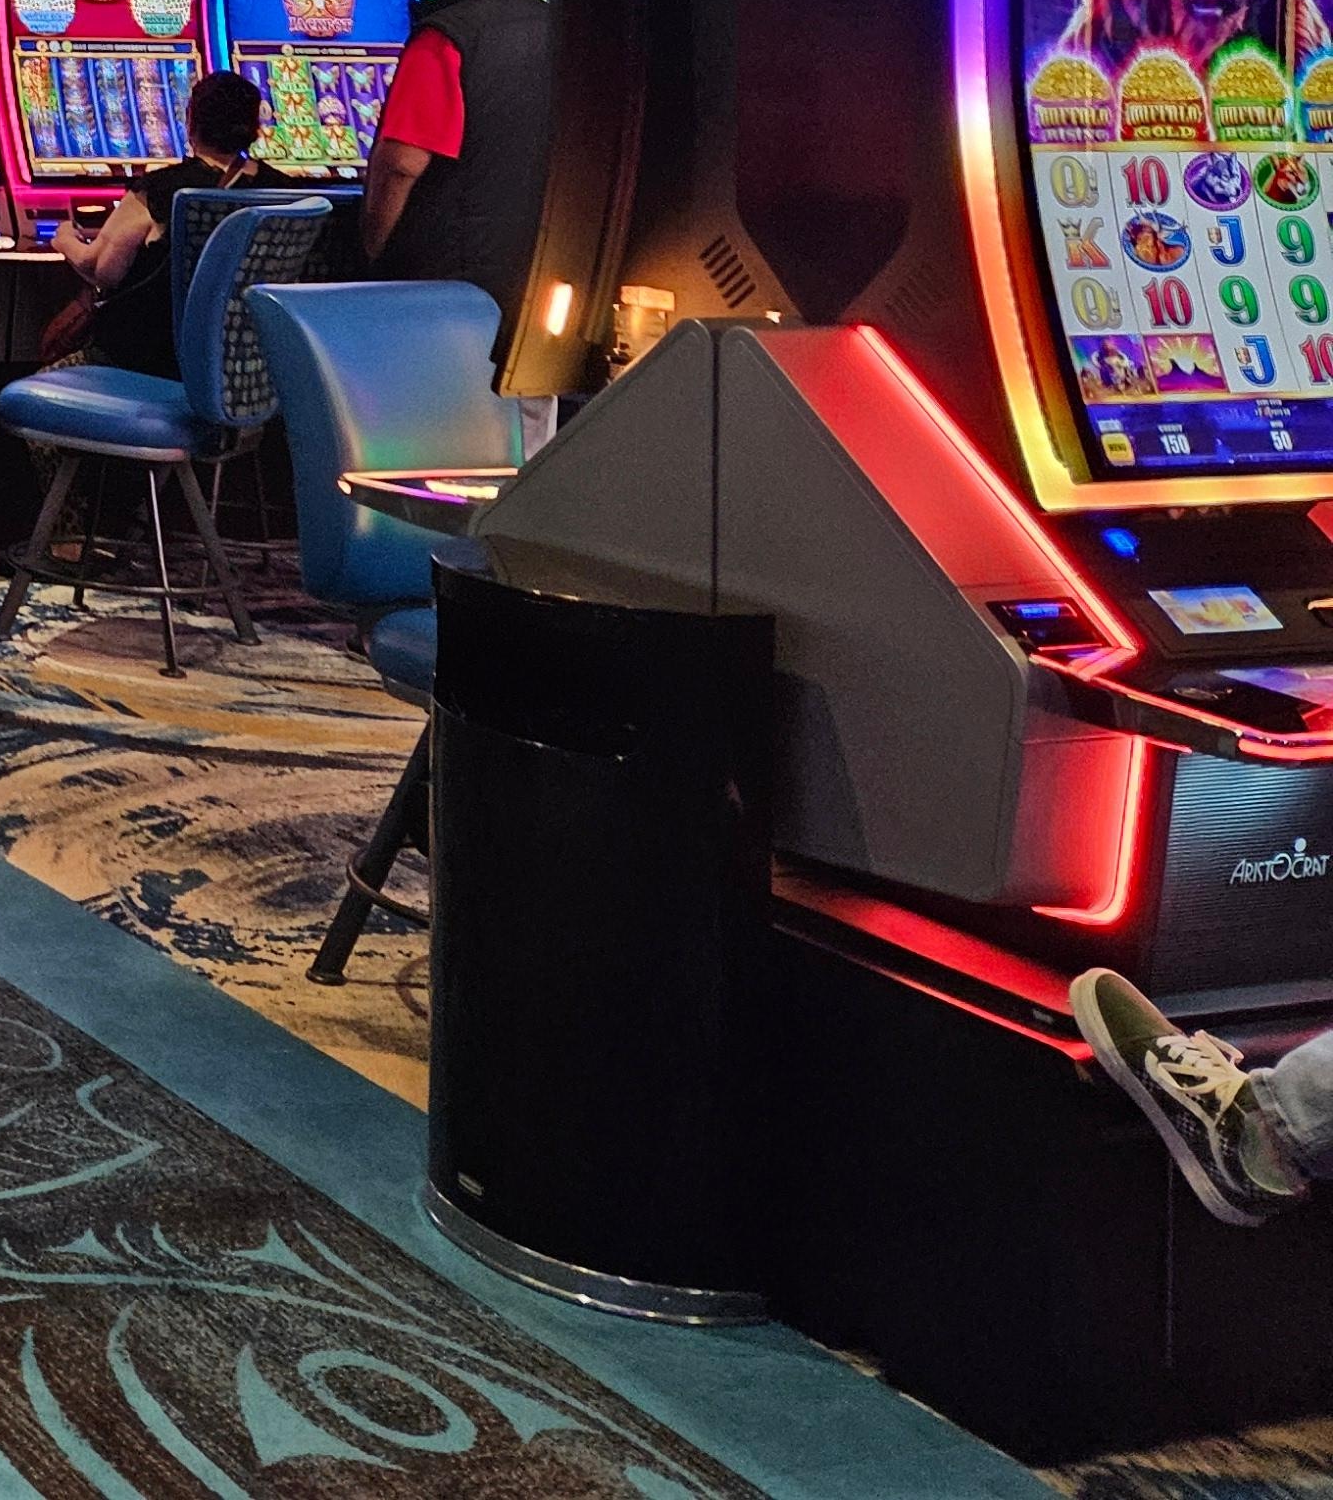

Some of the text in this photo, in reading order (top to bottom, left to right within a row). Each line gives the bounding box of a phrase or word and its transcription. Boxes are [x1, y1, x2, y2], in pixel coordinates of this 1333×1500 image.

[1045, 128, 1109, 141] RISING
[1127, 104, 1200, 125] BUFFALO
[1135, 126, 1196, 139] GOLD
[1050, 155, 1099, 209] Q
[1121, 155, 1170, 209] 10
[1065, 216, 1112, 270] K
[1210, 215, 1245, 267] J
[1276, 215, 1316, 267] 9
[1071, 276, 1123, 330] Q
[1142, 275, 1195, 329] 10
[1219, 274, 1260, 327] 9
[1289, 274, 1331, 327] 9
[1240, 334, 1278, 388] J
[1161, 434, 1191, 455] 150
[1269, 430, 1294, 451] 50
[1230, 850, 1331, 885] ARISTOCRAT
